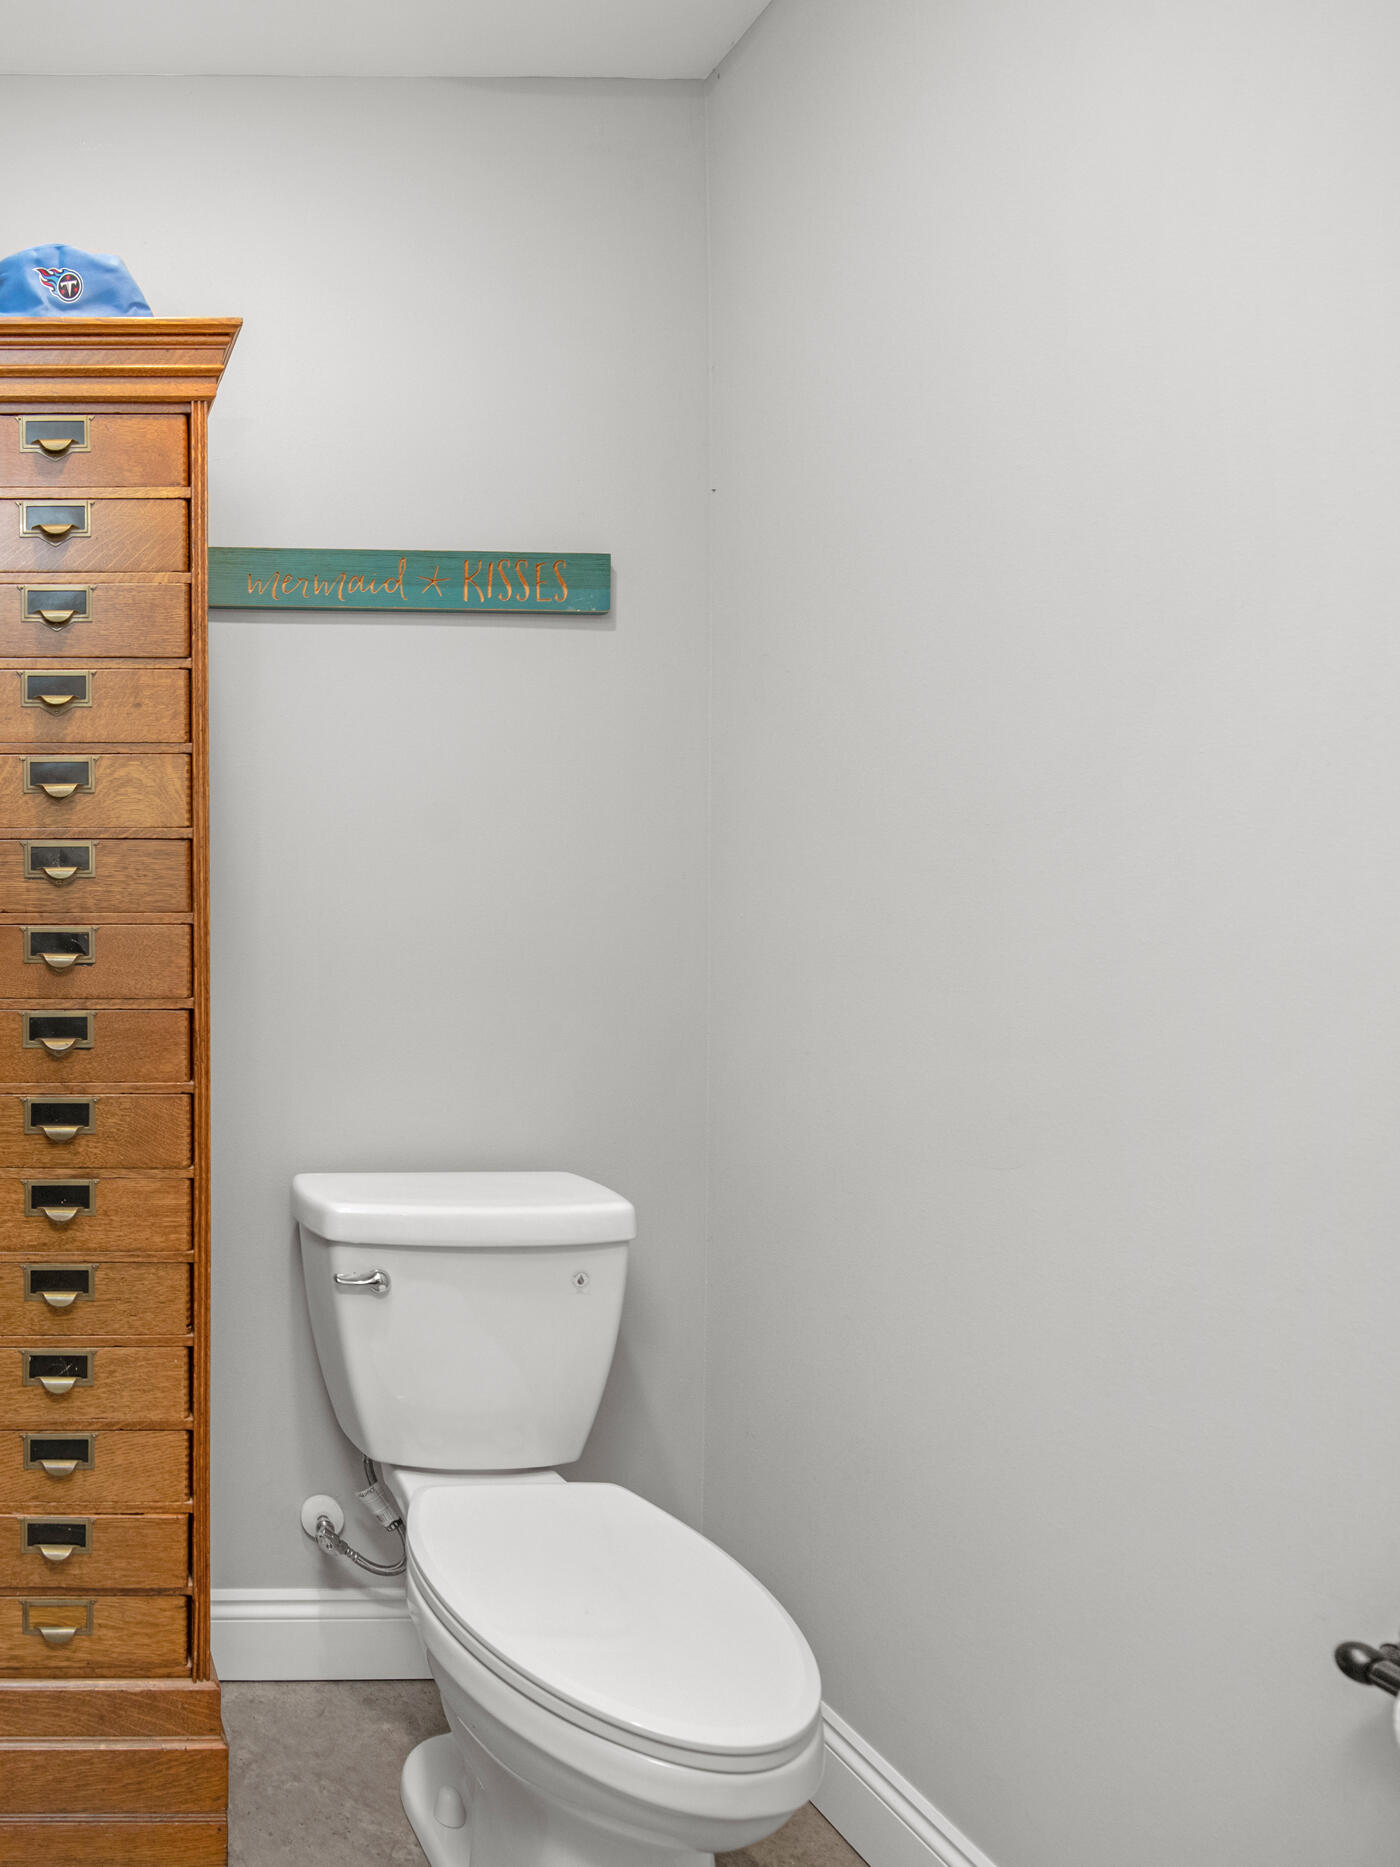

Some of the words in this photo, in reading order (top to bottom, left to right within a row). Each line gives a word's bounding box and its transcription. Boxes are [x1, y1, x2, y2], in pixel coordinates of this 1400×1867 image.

[60, 279, 78, 298] T
[247, 557, 408, 602] mermaid
[463, 558, 569, 603] KISSES
